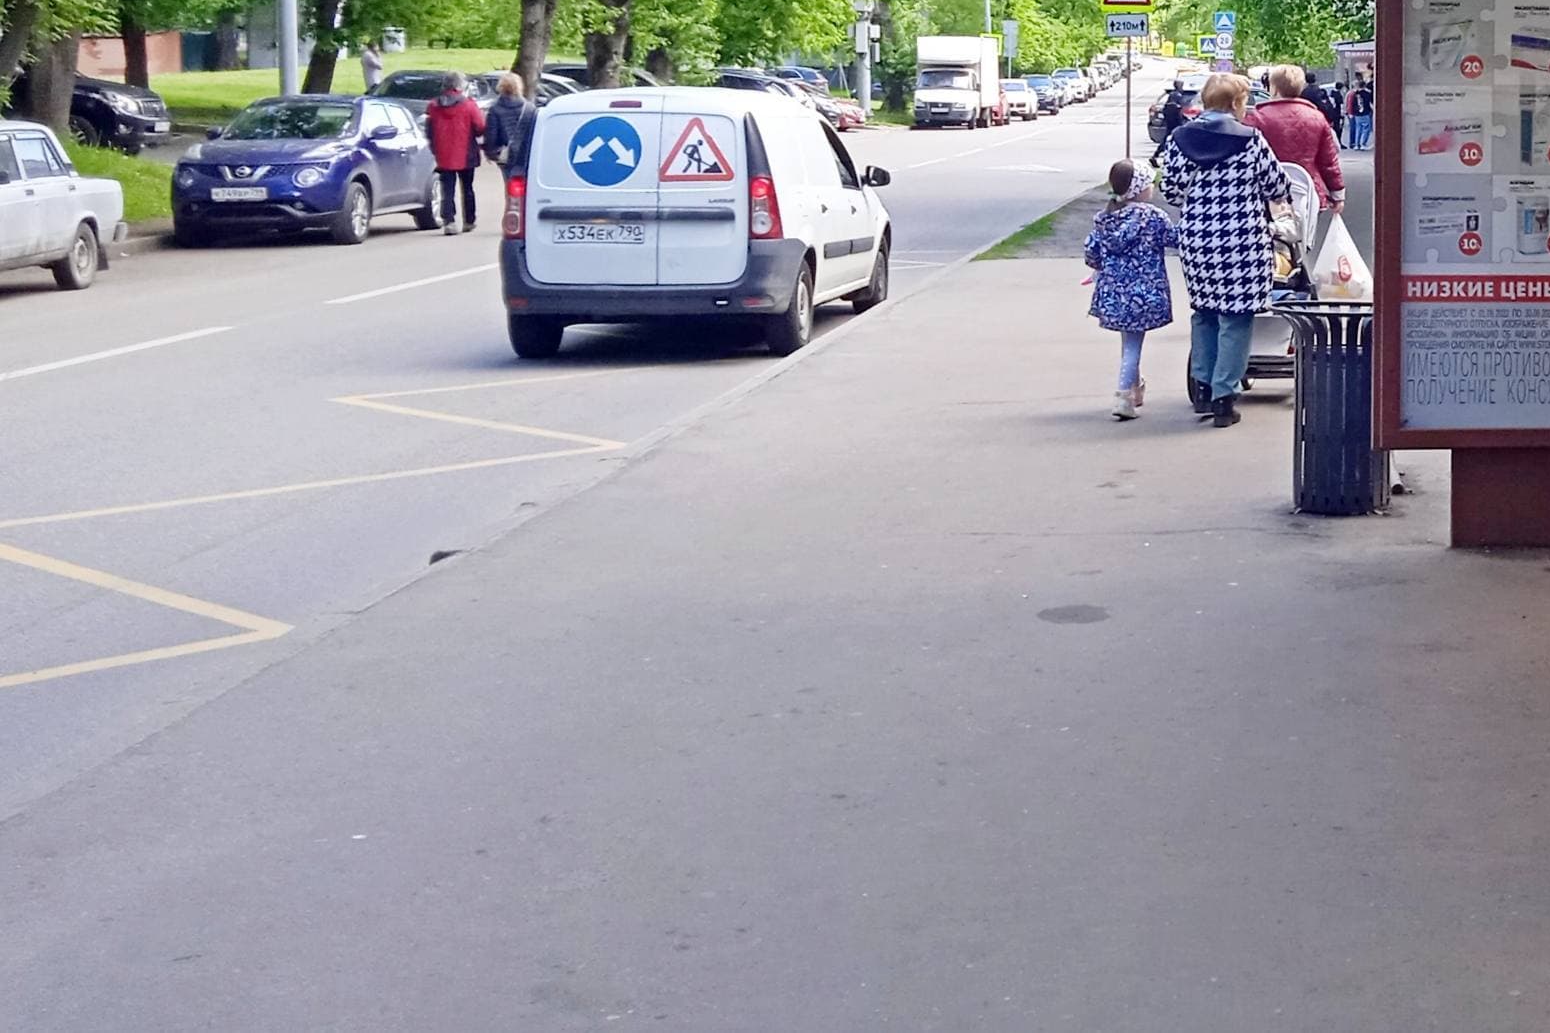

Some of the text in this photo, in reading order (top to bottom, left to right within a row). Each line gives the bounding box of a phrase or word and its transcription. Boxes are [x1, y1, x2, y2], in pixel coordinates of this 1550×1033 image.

[558, 226, 614, 241] Х534ЕК
[1406, 282, 1494, 297] НИЗКИЕ
[1406, 352, 1479, 377] ИМЕЮТСЯ
[1406, 379, 1497, 405] ПОЛУЧЕНИЕ
